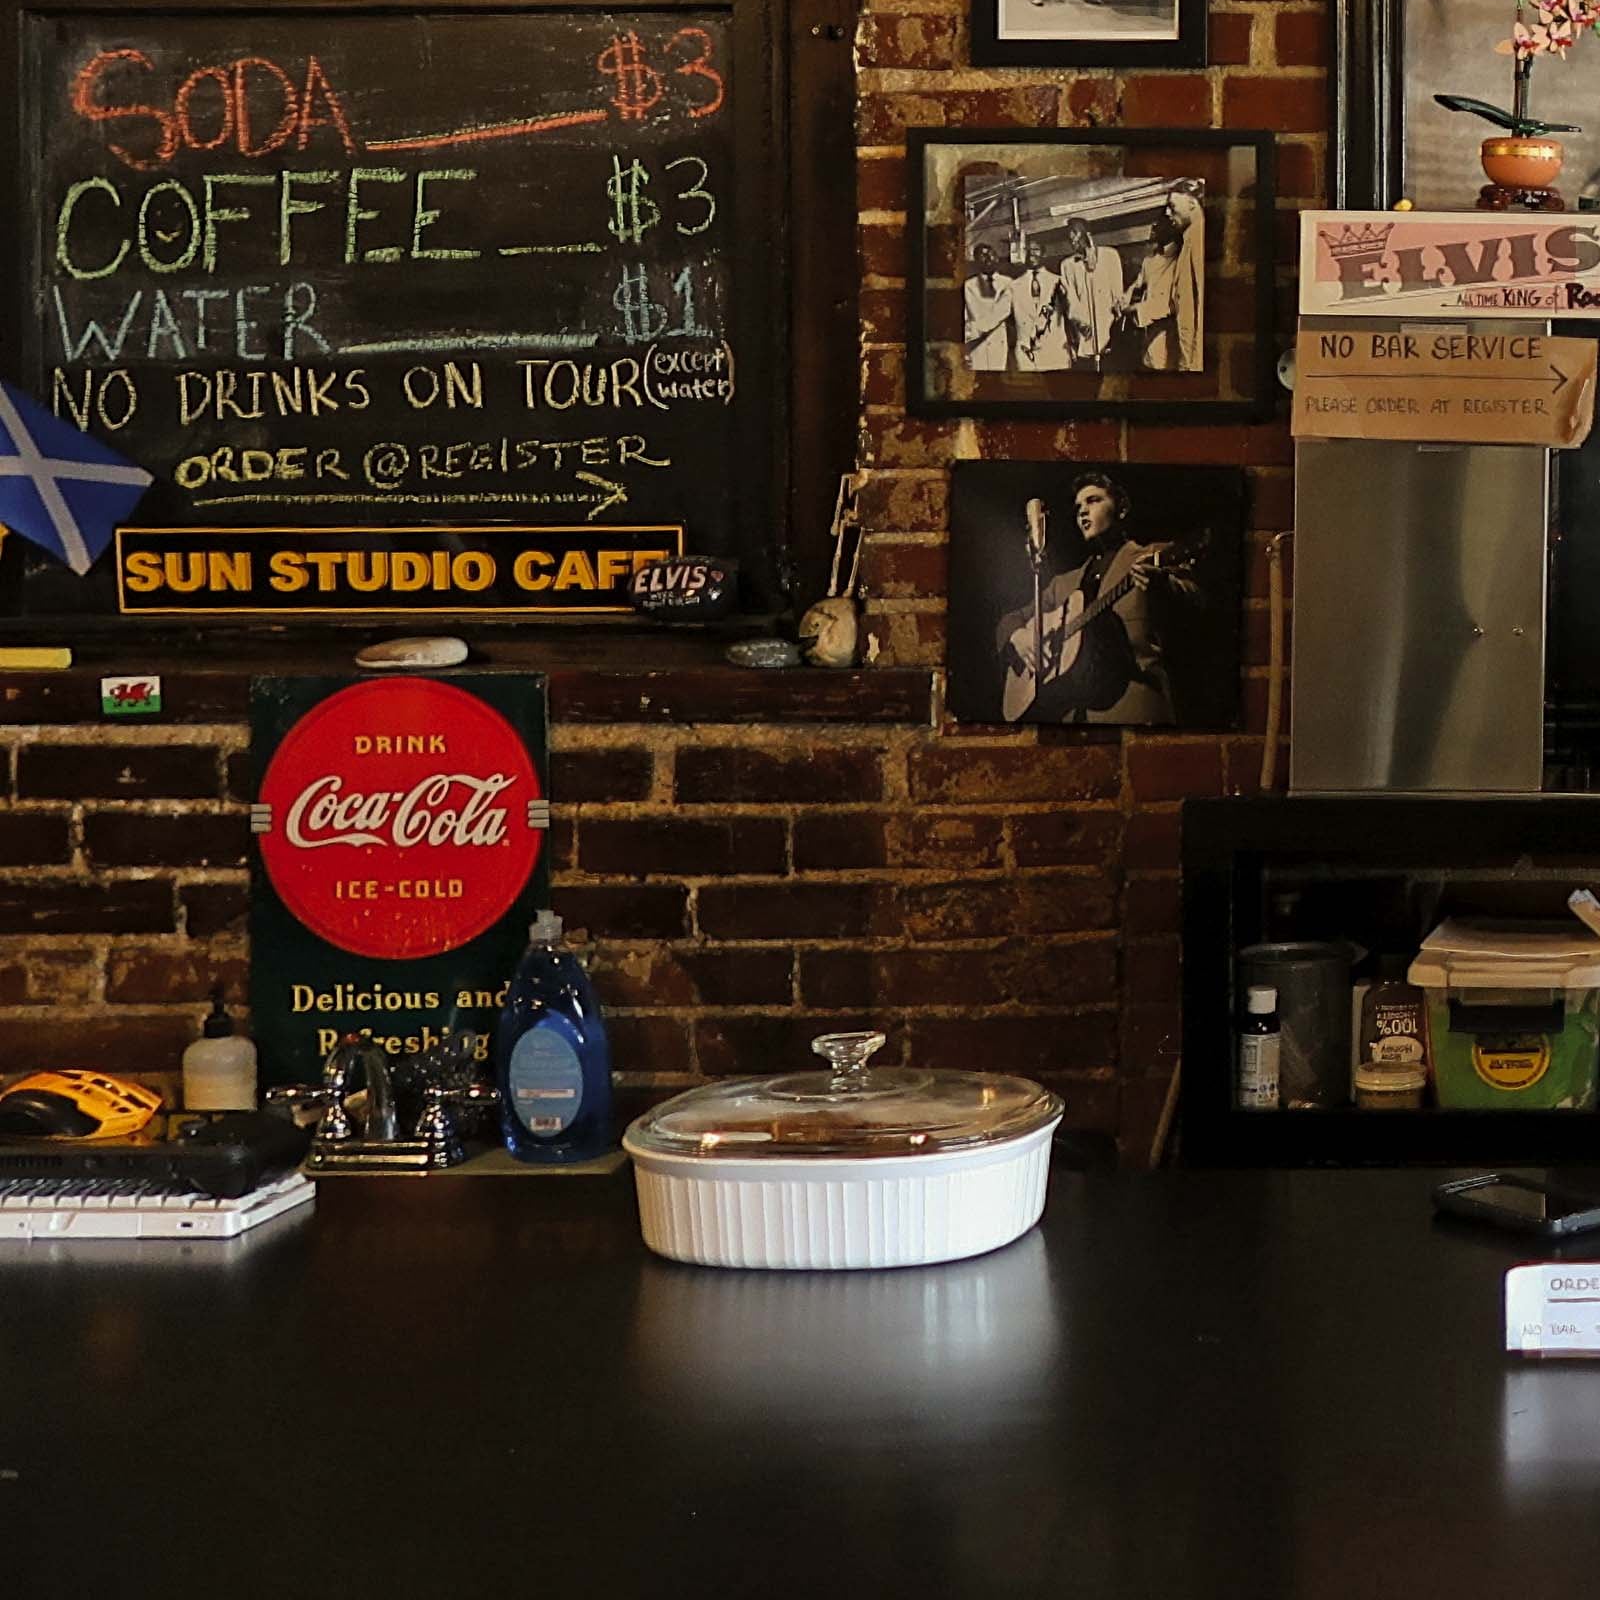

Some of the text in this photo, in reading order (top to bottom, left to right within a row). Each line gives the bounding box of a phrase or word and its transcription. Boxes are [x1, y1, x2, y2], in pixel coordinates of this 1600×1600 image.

[70, 28, 724, 169] SODA $3
[56, 156, 716, 281] COFFEE $3
[53, 266, 715, 361] WATER $1
[1502, 288, 1542, 308] KING
[1546, 284, 1560, 314] of
[1321, 334, 1544, 360] NO BAR SERVICE
[52, 357, 644, 431] NO DRINKS ON TOUR
[1305, 396, 1551, 416] PLEASE ORDER AT REGISTER
[176, 447, 348, 489] ORDER
[125, 550, 252, 592] SUN
[269, 550, 492, 592] STUDIO
[635, 565, 708, 594] ELVIS
[355, 735, 447, 755] DRINK
[287, 772, 517, 849] Coca-Cola
[336, 878, 464, 900] ICE-COLD
[291, 980, 512, 1013] Delicious and
